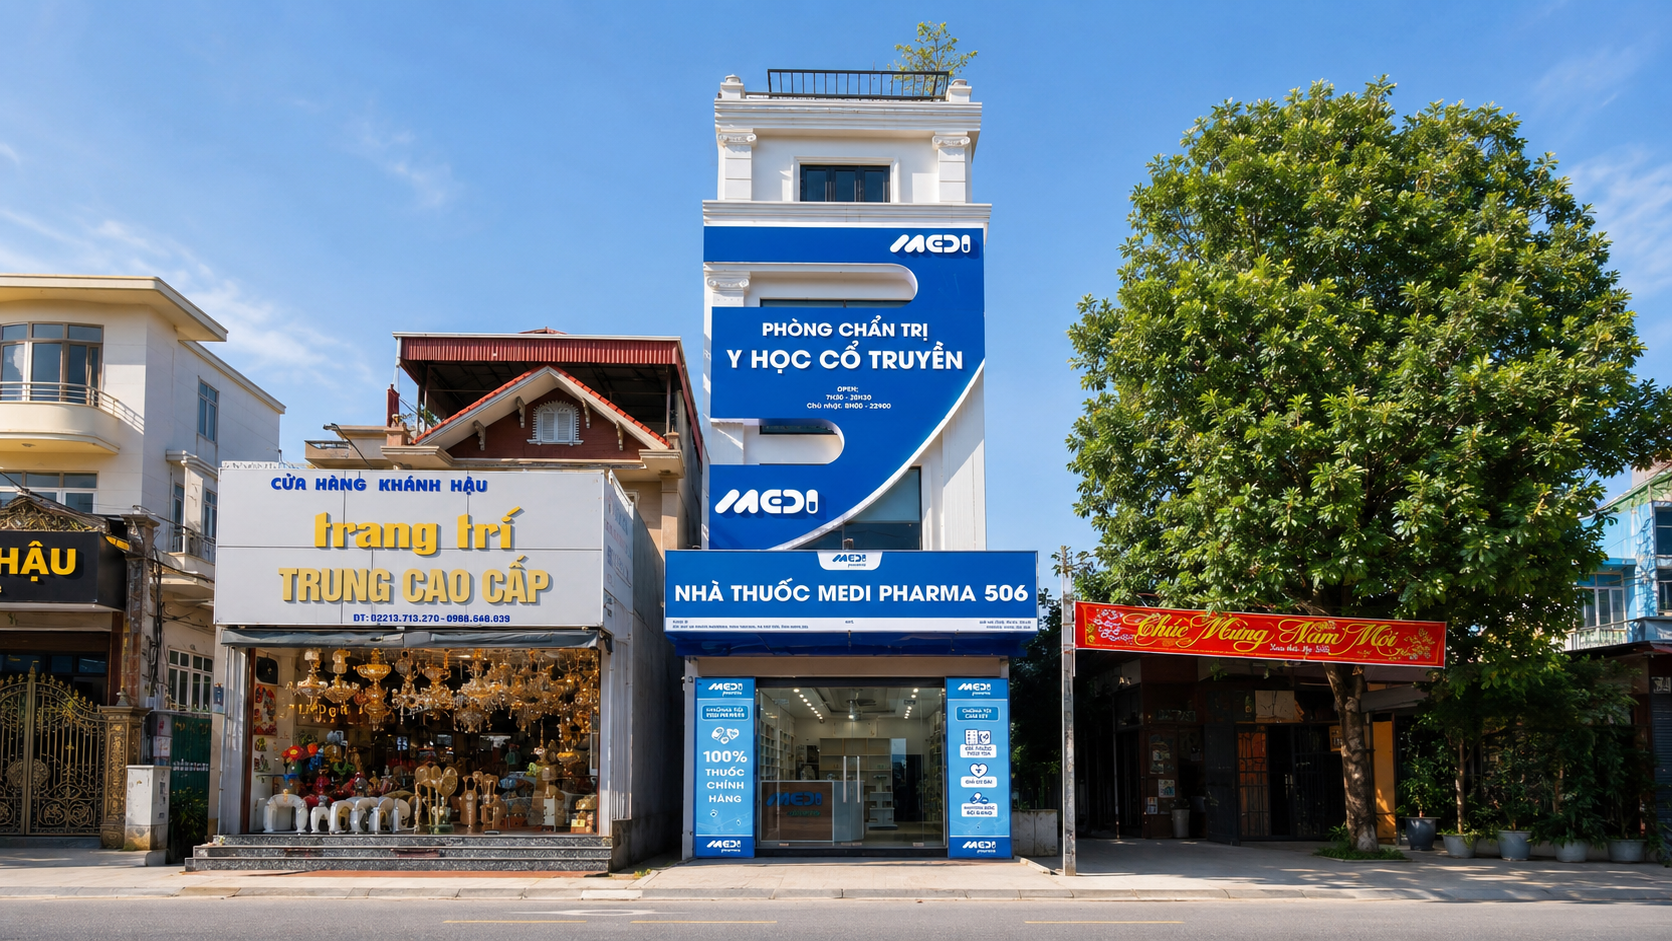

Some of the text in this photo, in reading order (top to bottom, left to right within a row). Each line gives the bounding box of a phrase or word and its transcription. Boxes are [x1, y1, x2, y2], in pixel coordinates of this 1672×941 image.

[889, 234, 971, 254] MEDI
[762, 315, 928, 342] PHÒNG CHẨN TRỊ
[727, 341, 963, 374] Y HỌC CỔ TRUYỀN
[271, 472, 488, 496] CỬA HÀNG KHÁNH HẬU
[714, 488, 819, 514] MEDI
[314, 506, 524, 556] trang trí
[832, 554, 867, 562] MEDI
[279, 555, 550, 603] TRUNG CAO CẤP
[675, 577, 1029, 602] NHÀ THUỐC MEDI PHARMA 506
[1123, 613, 1190, 646] Chúc
[708, 682, 743, 691] MEDI
[957, 682, 991, 691] MEDI
[703, 750, 748, 763] 100%
[705, 766, 745, 777] THUỐC
[706, 779, 745, 790] CHÍNH
[766, 791, 823, 806] MEDI
[706, 839, 741, 848] MEDI
[962, 840, 996, 849] MEDI
